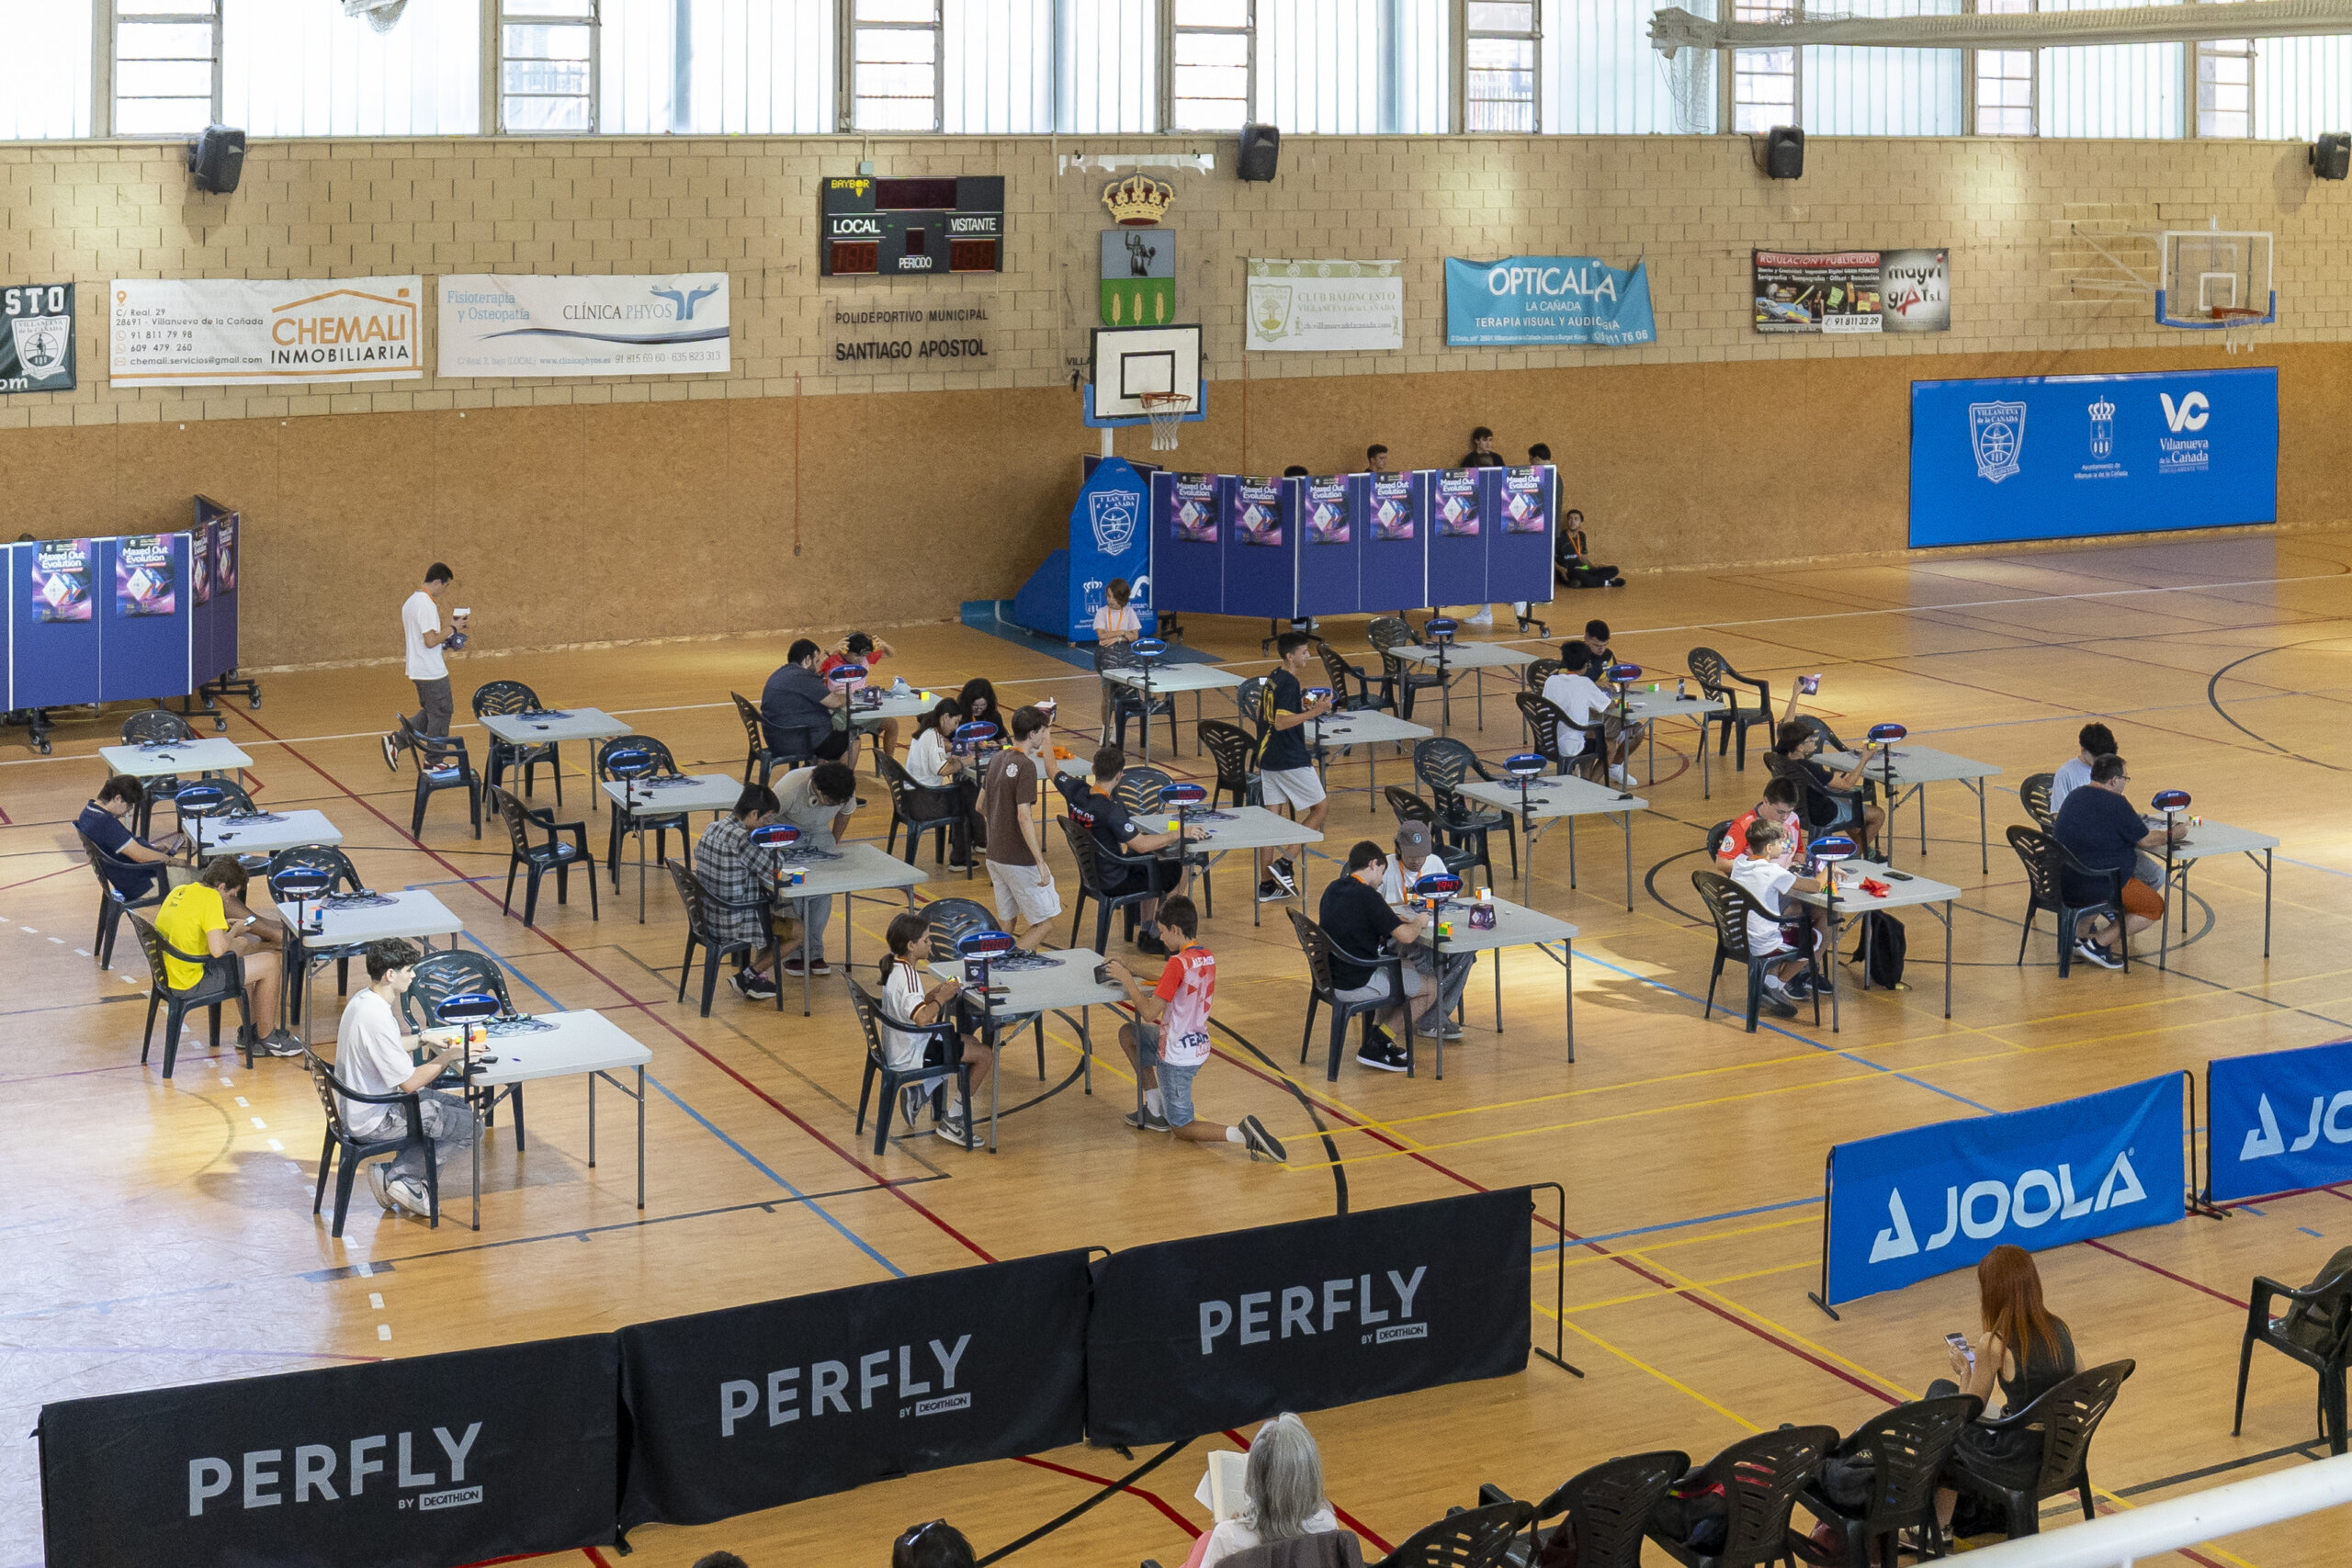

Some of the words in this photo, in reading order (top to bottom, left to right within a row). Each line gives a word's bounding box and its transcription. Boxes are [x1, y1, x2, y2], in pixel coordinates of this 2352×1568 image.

[833, 220, 880, 233] LOCAL
[951, 218, 996, 231] VISITANTE
[899, 257, 932, 268] PERIODO
[1826, 255, 1877, 265] PUBLICIDAD
[6, 286, 64, 315] STO
[447, 290, 515, 306] Fisioterapia
[1297, 292, 1326, 302] CLUB
[1329, 290, 1396, 302] BALONCESTO
[562, 300, 622, 321] CLÍNICA
[626, 303, 673, 320] PHYOS
[1525, 301, 1537, 311] LA
[1540, 299, 1581, 311] CAÑADA
[116, 309, 127, 317] C/
[458, 310, 464, 322] y
[469, 306, 530, 321] Osteopatía
[836, 310, 922, 323] POLIDEPORTIVO
[929, 309, 988, 321] MUNICIPAL
[116, 318, 141, 326] 28691
[152, 318, 198, 326] Villanueva
[226, 317, 264, 325] Cañada
[1475, 317, 1521, 328] TERAPIA
[1522, 317, 1555, 327] VISUAL
[1559, 317, 1565, 326] Y
[1834, 316, 1843, 325] 91
[1846, 316, 1858, 325] 811
[130, 331, 141, 339] 91
[145, 331, 162, 339] 811
[182, 330, 193, 338] 98
[272, 314, 406, 345] CHEMALI
[1622, 332, 1634, 342] 76
[1635, 330, 1649, 340] 06
[130, 344, 147, 353] 609
[153, 344, 170, 352] 479
[176, 343, 193, 351] 260
[271, 344, 410, 365] INMOBILIARIA
[836, 341, 912, 361] SANTIAGO
[919, 339, 988, 357] APOSTOL
[615, 355, 624, 364] 91
[2160, 438, 2209, 450] Villanueva
[2171, 450, 2209, 463] Cañada
[68, 550, 85, 559] Out
[152, 545, 168, 554] Out
[42, 558, 82, 568] Evolution
[126, 554, 164, 564] Evolution
[1926, 1152, 2147, 1251] JOOLA
[1200, 1266, 1427, 1355] PERFLY
[1361, 1334, 1373, 1345] BY
[1379, 1325, 1424, 1342] DECATHLON
[720, 1334, 972, 1438] PERFLY
[899, 1406, 911, 1418] BY
[920, 1395, 967, 1413] DECATHLON
[189, 1421, 482, 1517] PERFLY
[399, 1499, 413, 1509] BY
[424, 1488, 480, 1506] DECATHLON
